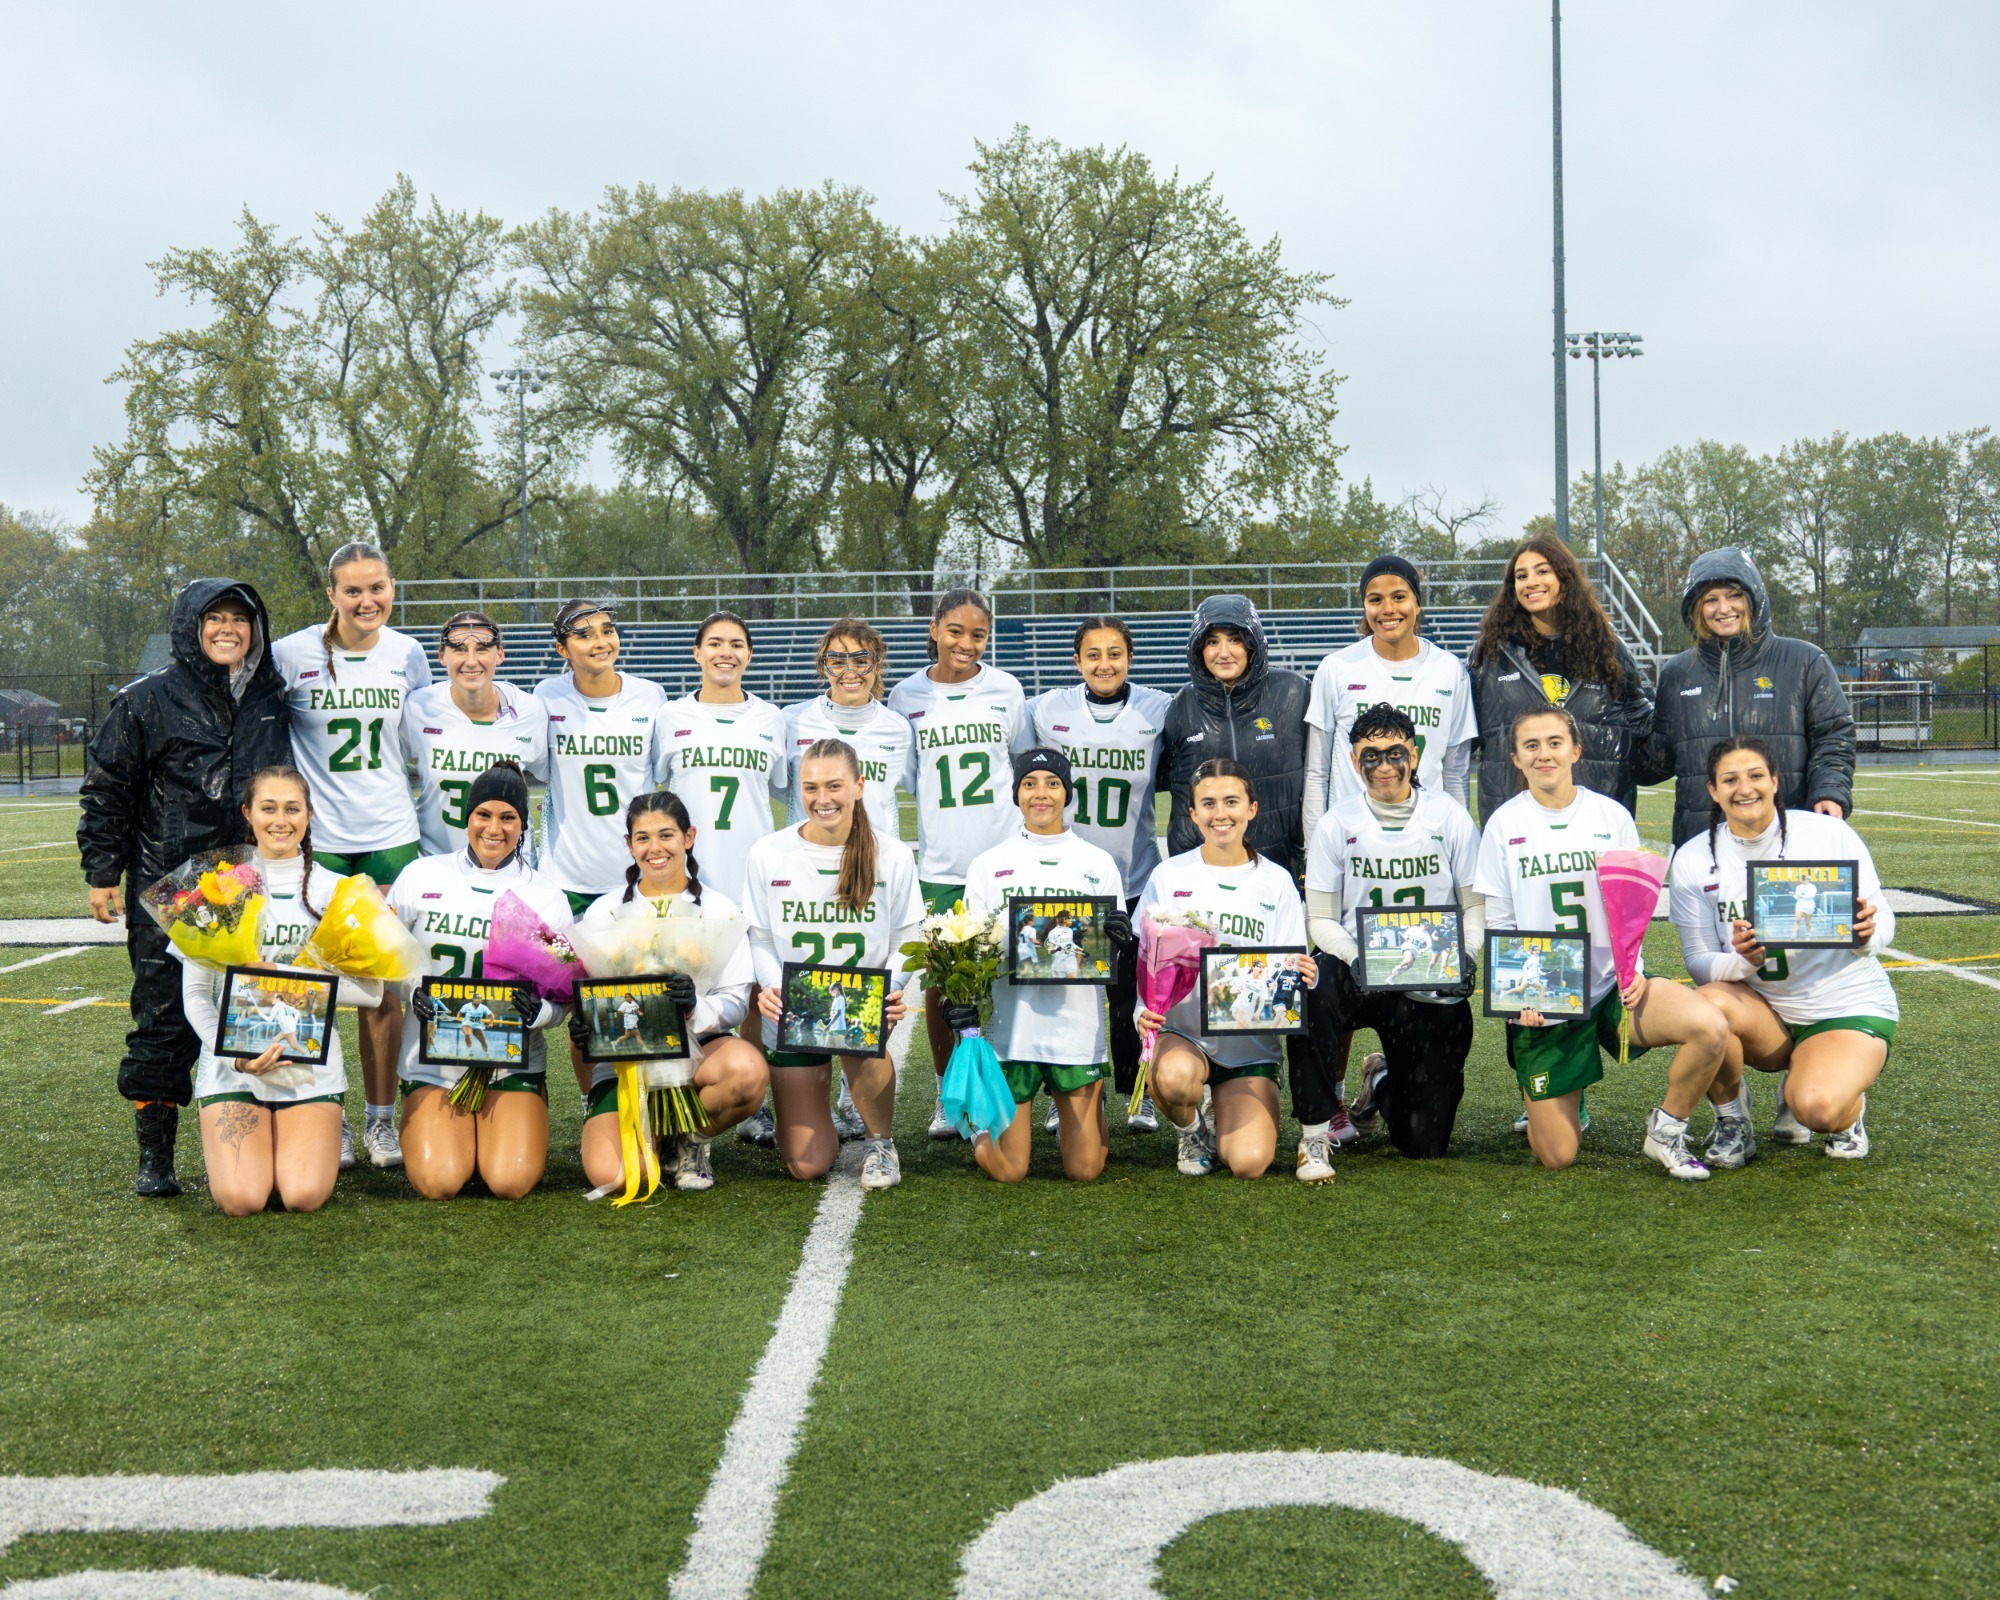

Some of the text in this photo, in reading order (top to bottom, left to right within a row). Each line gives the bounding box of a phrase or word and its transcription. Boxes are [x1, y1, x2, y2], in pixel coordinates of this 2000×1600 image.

[310, 688, 400, 710] FALCONS
[327, 717, 384, 772] 21
[556, 735, 643, 756] FALCONS
[918, 723, 1002, 750] FALCONS
[682, 746, 768, 772] FALCONS
[1061, 744, 1145, 771] FALCONS
[584, 764, 620, 816] 6
[936, 752, 994, 808] 12
[710, 776, 740, 830] 7
[1072, 776, 1132, 827] 10
[1351, 854, 1440, 879] FALCONS
[1519, 850, 1597, 878] FALCON
[782, 901, 876, 923] FALCONS
[1033, 902, 1094, 917] GARCIA
[1550, 881, 1588, 932] 5
[425, 911, 491, 940] FALCO
[792, 931, 865, 967] 22
[1523, 937, 1552, 952] FOX
[1239, 953, 1269, 968] FOX
[258, 975, 306, 995] LOPEZ
[430, 983, 518, 1001] GONCALVE
[1532, 1075, 1548, 1095] F
